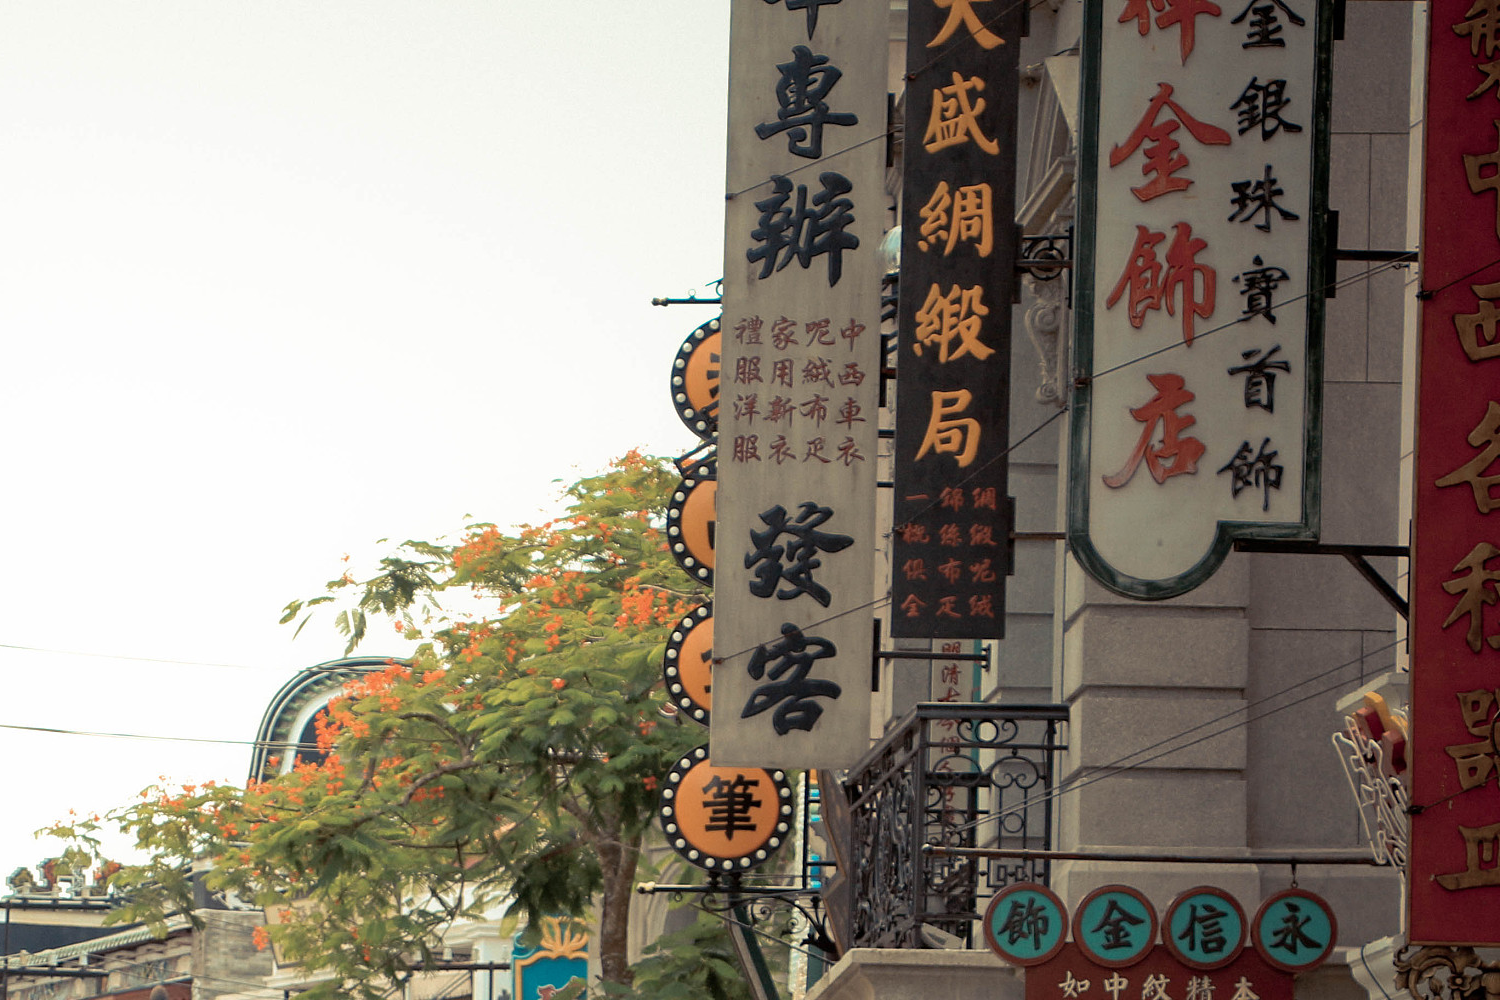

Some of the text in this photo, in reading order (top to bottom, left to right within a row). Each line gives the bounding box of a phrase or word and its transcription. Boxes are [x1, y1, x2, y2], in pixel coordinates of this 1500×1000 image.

[1216, 0, 1306, 512] 金銀珠寶首飾
[740, 500, 855, 737] 發客
